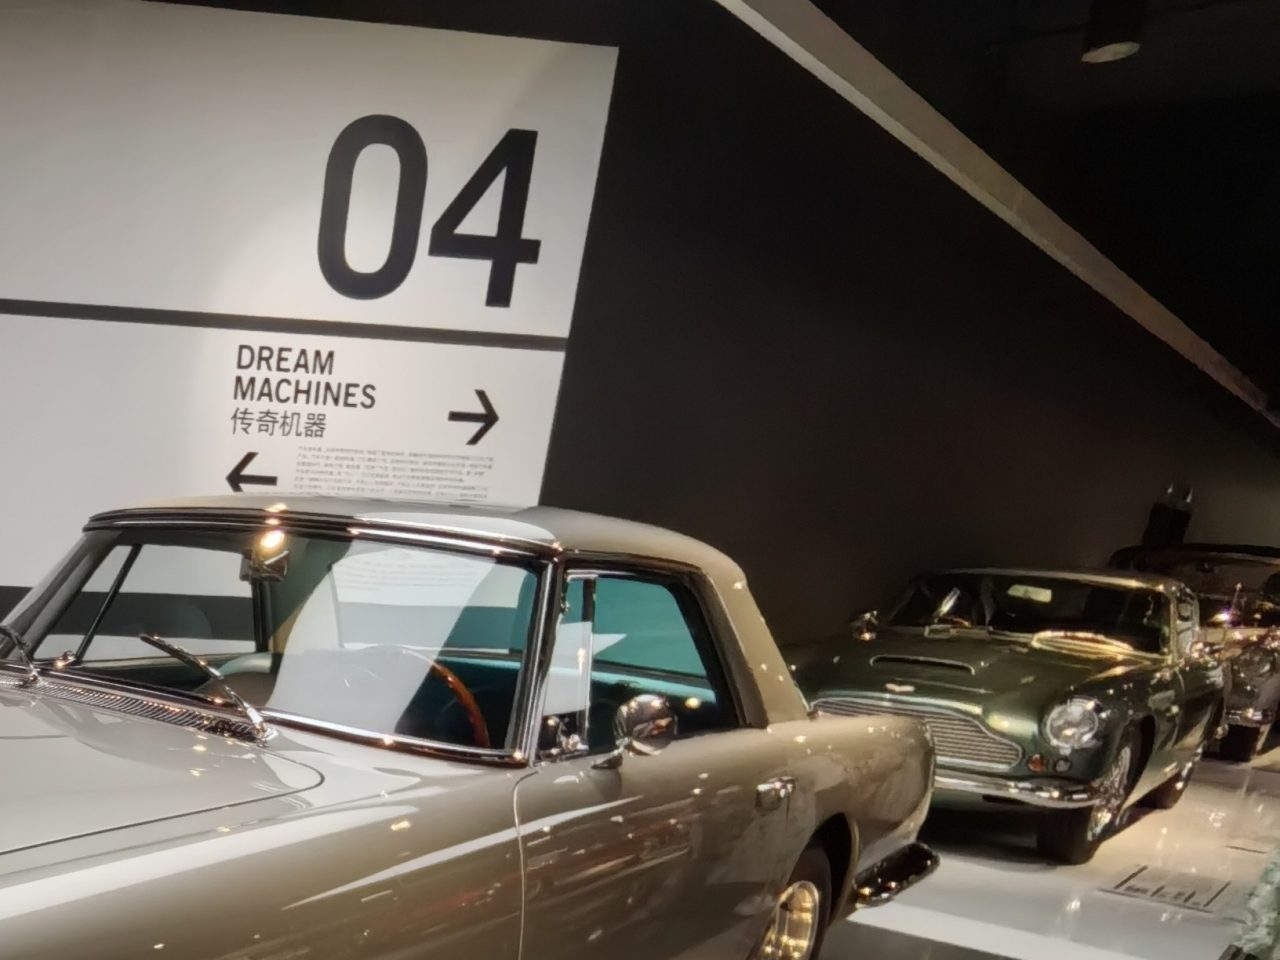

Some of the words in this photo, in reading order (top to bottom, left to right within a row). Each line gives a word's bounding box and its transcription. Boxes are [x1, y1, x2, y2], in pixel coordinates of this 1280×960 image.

[317, 114, 541, 308] 04
[236, 345, 335, 375] DREAM
[232, 376, 376, 410] MACHINES
[230, 407, 327, 439] 传奇机器
